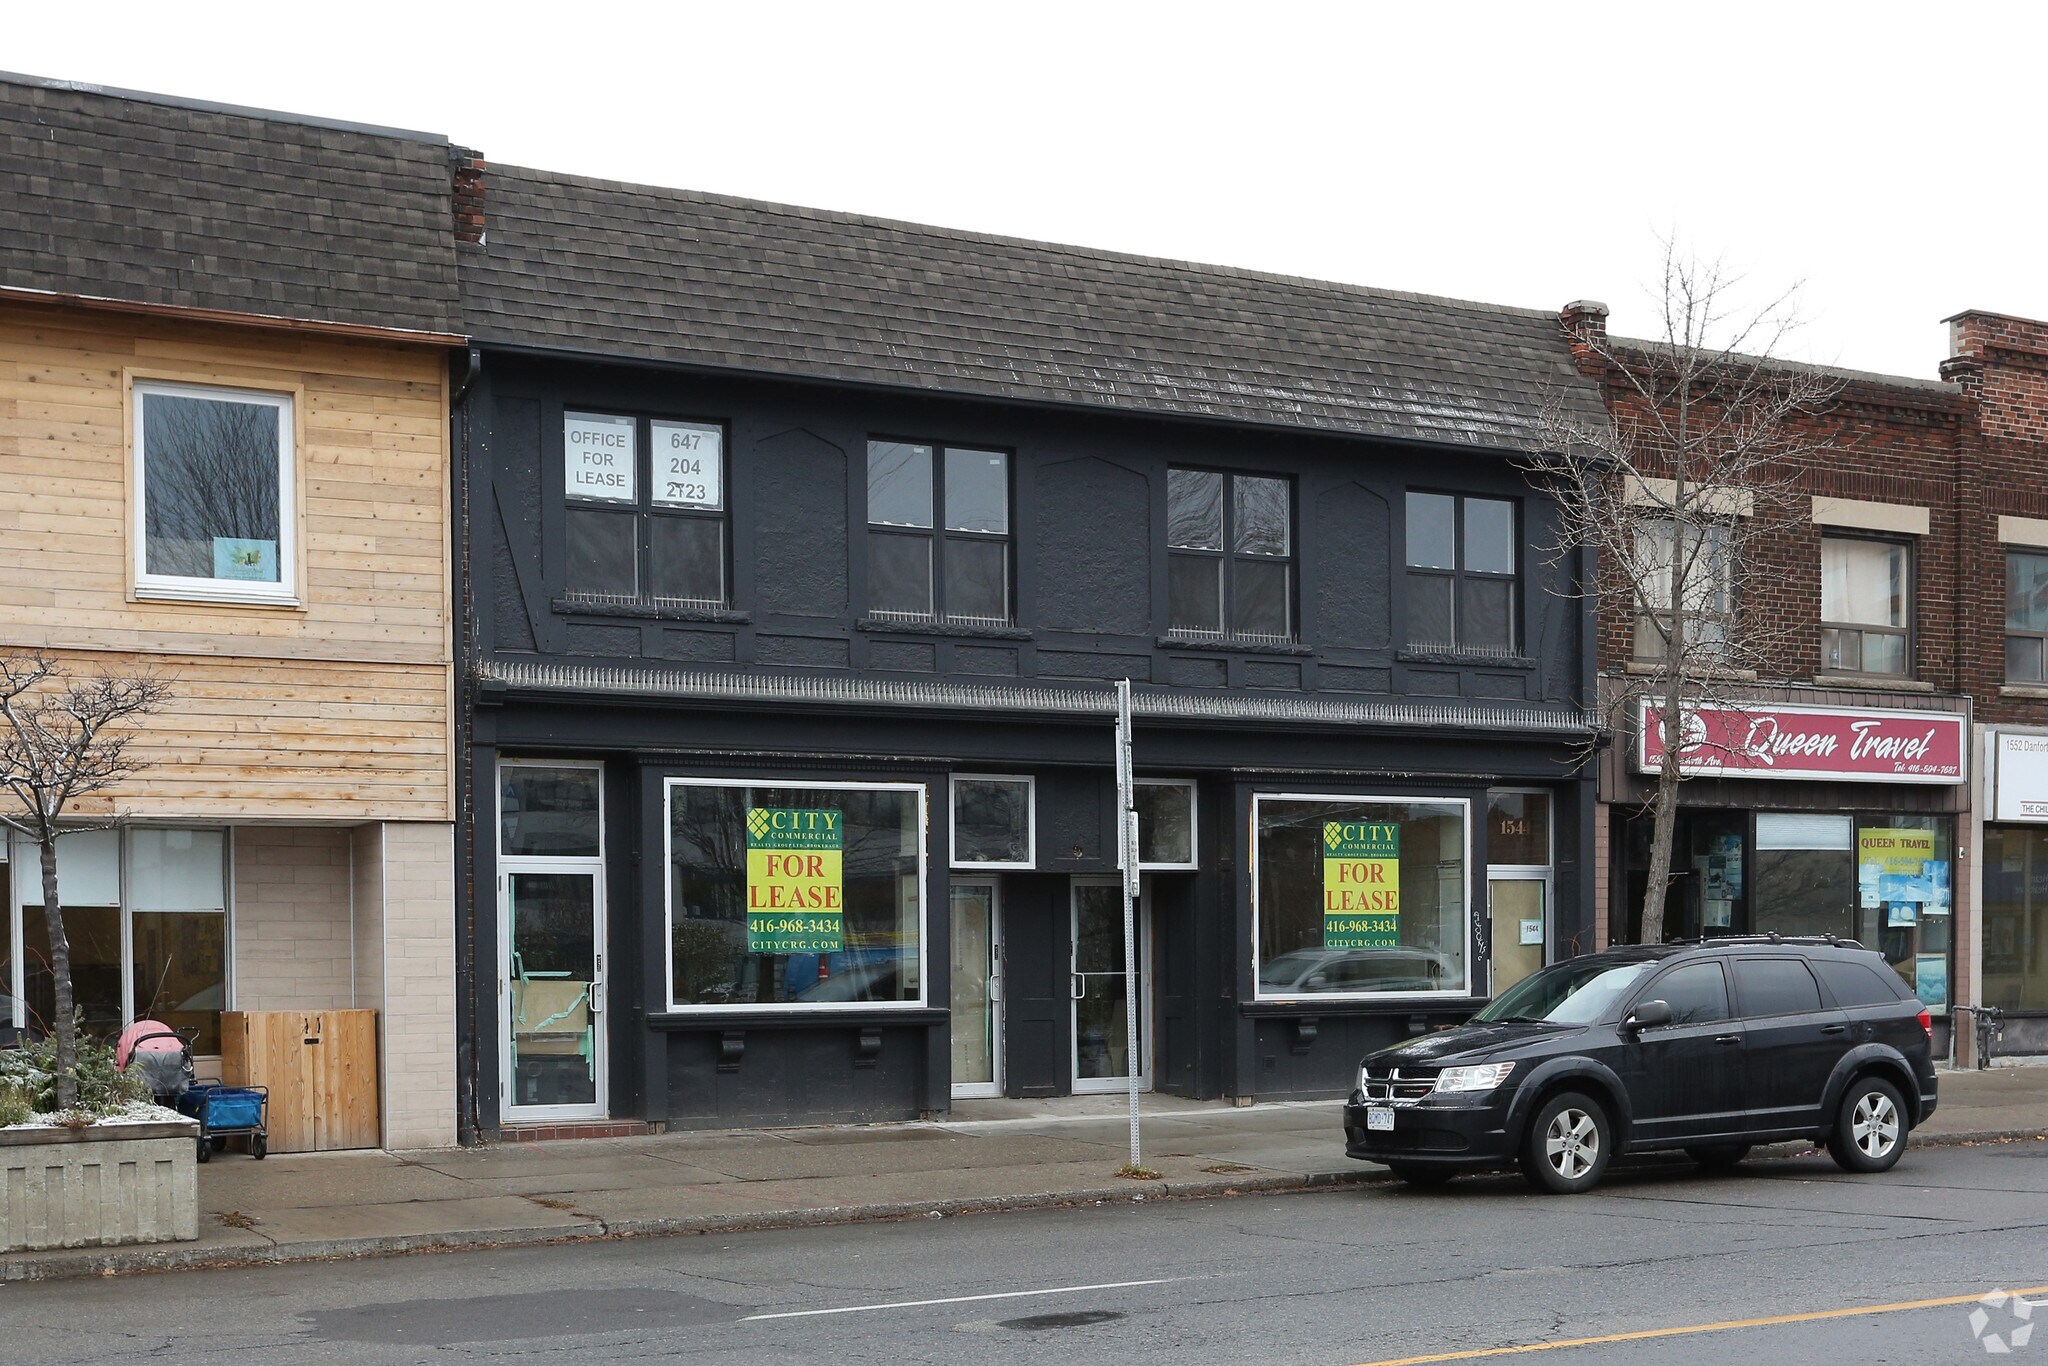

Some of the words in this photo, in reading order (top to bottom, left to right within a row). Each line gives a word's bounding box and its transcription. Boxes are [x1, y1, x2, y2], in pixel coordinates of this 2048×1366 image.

[570, 430, 626, 448] OFFICE
[671, 433, 701, 450] 647
[583, 452, 614, 466] FOR
[670, 458, 701, 475] 204
[576, 471, 626, 487] LEASE
[1744, 716, 1839, 765] Queen
[1850, 720, 1936, 761] Travel
[2006, 739, 2023, 751] 1552
[1704, 755, 1722, 766] Ave.
[1894, 761, 1906, 773] Tel:
[1908, 764, 1958, 775] 416-504-7687
[2021, 804, 2034, 813] THE
[771, 811, 838, 830] CITY
[770, 832, 838, 840] COMMERCIAL
[1343, 824, 1396, 841] CITY
[1861, 838, 1896, 849] QUEEN
[1900, 838, 1931, 849] TRAVEL
[766, 854, 825, 878] FOR
[1338, 862, 1385, 884] FOR
[749, 885, 841, 909] LEASE
[1326, 890, 1398, 911] LEASE
[750, 919, 840, 933] 416-968-3434
[1326, 919, 1397, 933] 416-968-3434
[751, 940, 839, 949] CITYCRG.COM
[1327, 939, 1396, 947] CITYCRG.COM
